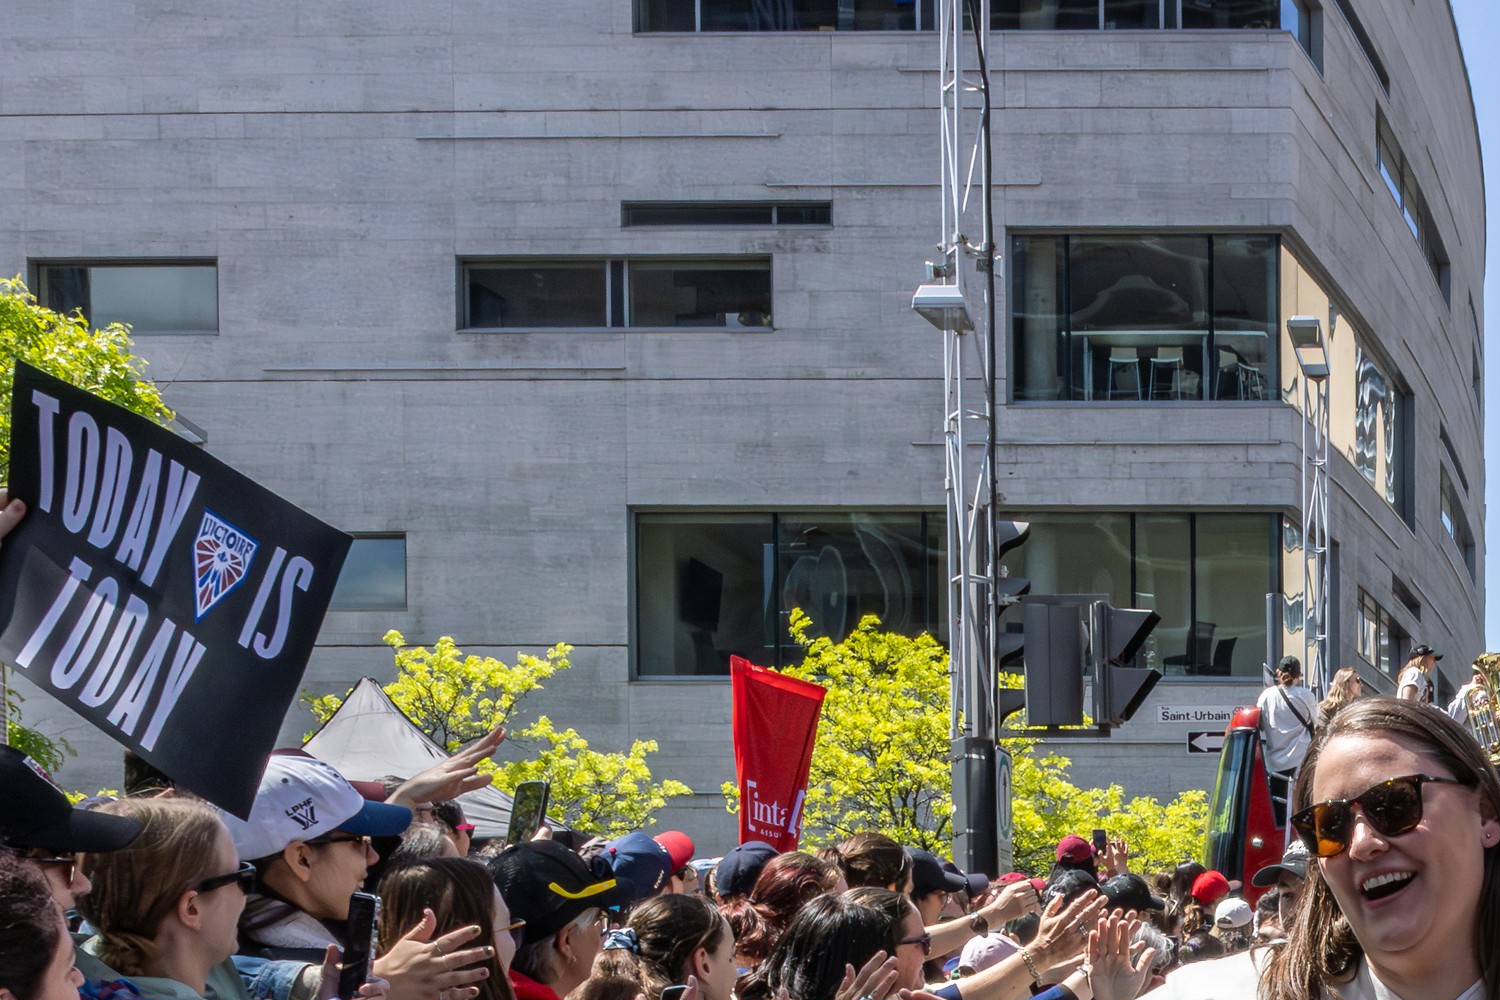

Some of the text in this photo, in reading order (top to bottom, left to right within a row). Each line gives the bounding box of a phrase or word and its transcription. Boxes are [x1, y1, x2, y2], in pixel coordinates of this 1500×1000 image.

[32, 389, 315, 660] TODAY IS
[200, 517, 254, 569] VICTOIRE
[15, 556, 206, 752] TODAY
[1162, 711, 1231, 721] Saint-Urbain
[285, 797, 312, 816] LPHF
